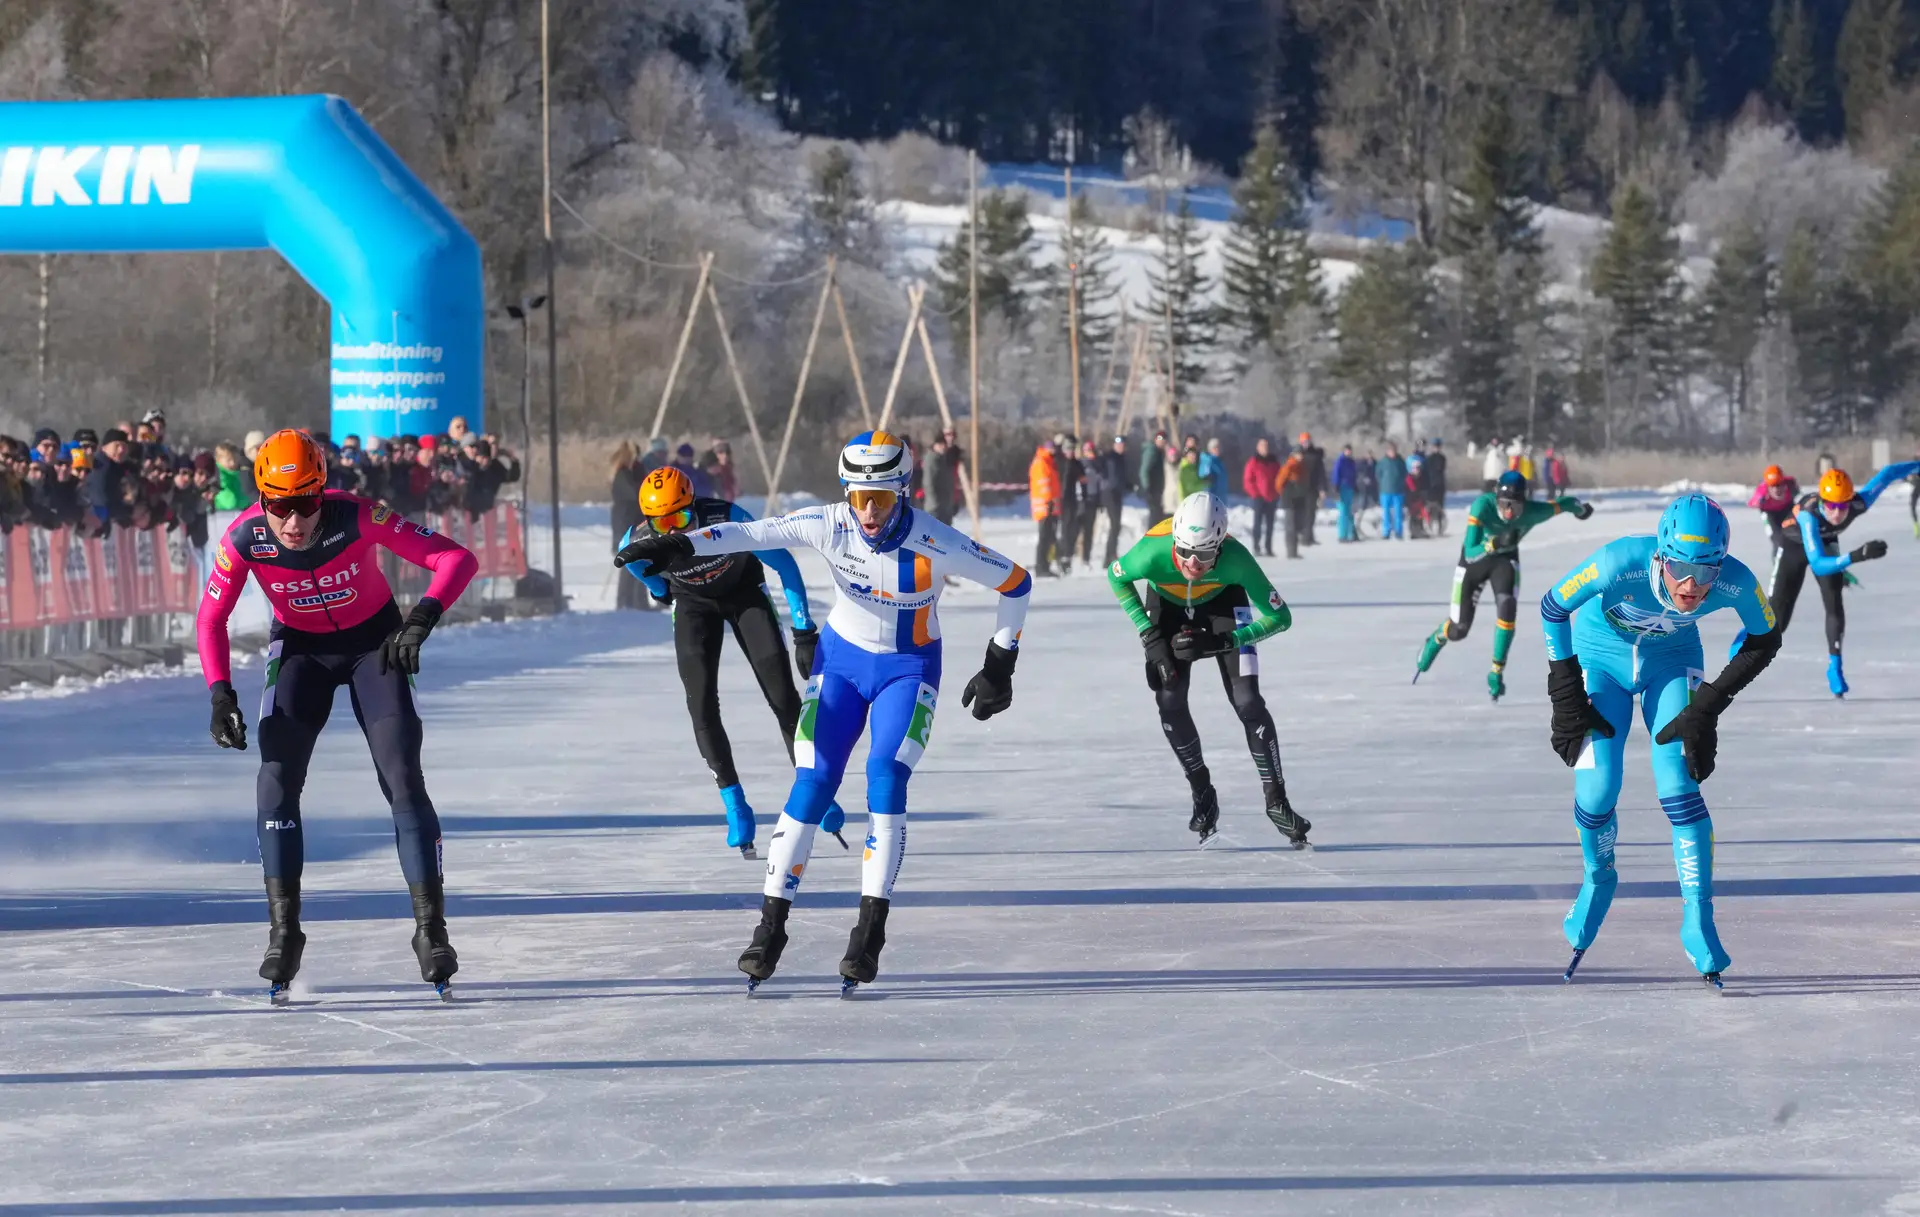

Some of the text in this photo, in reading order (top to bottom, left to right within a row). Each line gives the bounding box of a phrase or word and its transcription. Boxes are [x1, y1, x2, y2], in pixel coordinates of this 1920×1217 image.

[322, 530, 346, 548] JUMBO
[980, 556, 1009, 571] WESTERHOFF
[270, 562, 360, 593] essent
[1558, 563, 1599, 601] xenos
[1615, 570, 1649, 582] A-WARE
[1712, 580, 1743, 597] -WARE
[293, 590, 349, 606] unox
[873, 594, 936, 609] WESTERHOFF
[265, 820, 297, 830] FILA
